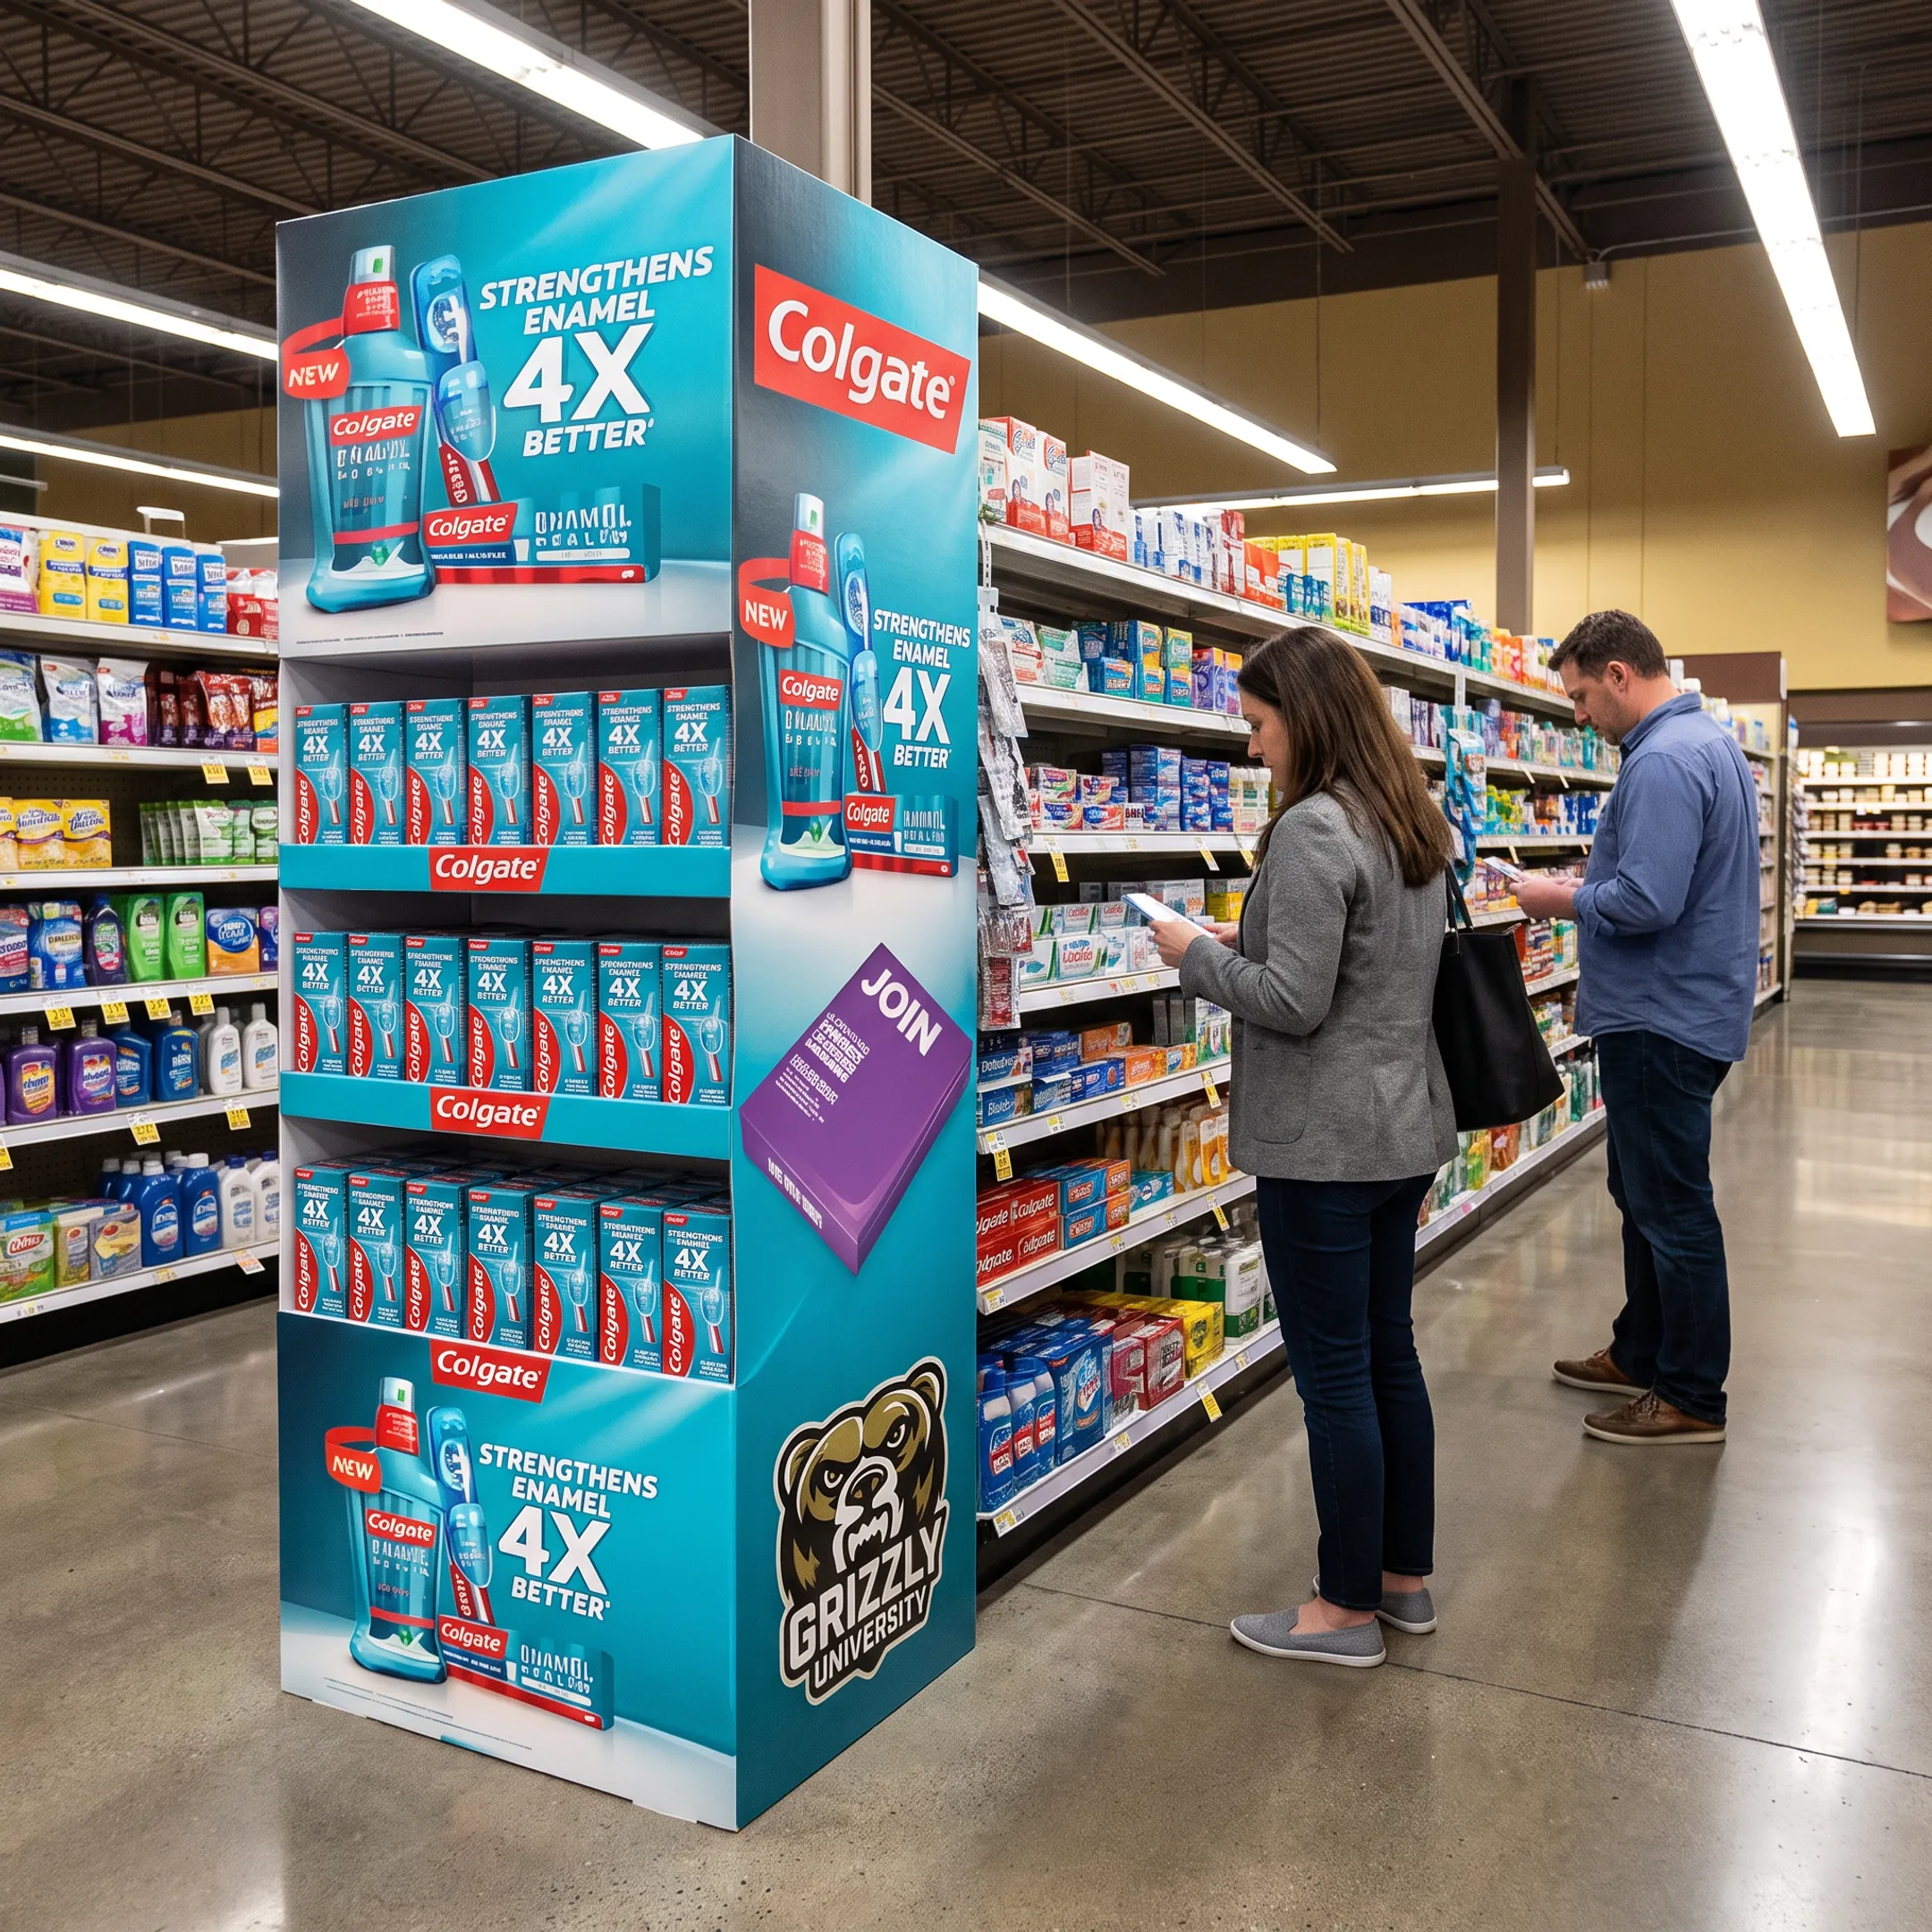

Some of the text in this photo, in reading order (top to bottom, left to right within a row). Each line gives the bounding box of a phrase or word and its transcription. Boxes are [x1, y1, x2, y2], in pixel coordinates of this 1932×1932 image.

[479, 246, 714, 309] STRENGTHENS
[523, 290, 655, 335] ENAMEL
[288, 362, 339, 387] NEW
[504, 323, 654, 423] 4X
[334, 412, 415, 437] Colgate
[428, 514, 508, 539] Colgate
[744, 599, 788, 631] NEW
[873, 608, 971, 648] STRENGTHENS
[893, 642, 951, 670] ENAMEL
[782, 675, 839, 702] Colgate
[884, 666, 952, 744] 4X
[303, 735, 329, 753] 4X
[359, 734, 386, 752] 4X
[415, 733, 444, 750] 4X
[478, 730, 506, 749] 4X
[542, 727, 572, 748] 4X
[608, 724, 640, 744] 4X
[674, 722, 708, 743] 4X
[846, 801, 890, 826] Colgate
[436, 853, 539, 886] Colgate
[302, 962, 328, 981] 4X
[358, 966, 385, 986] 4X
[414, 969, 443, 989] 4X
[478, 972, 507, 993] 4X
[542, 975, 574, 996] 4X
[609, 978, 641, 999] 4X
[674, 979, 708, 1001] 4X
[673, 1000, 708, 1010] BETTER
[861, 969, 943, 1057] JOIN
[436, 1095, 540, 1128] Colgate
[303, 1199, 330, 1220] 4X
[358, 1207, 385, 1228] 4X
[414, 1215, 443, 1236] 4X
[478, 1224, 507, 1246] 4X
[543, 1232, 576, 1255] 4X
[609, 1241, 642, 1264] 4X
[674, 1248, 709, 1272] 4X
[437, 1350, 541, 1390] Colgate
[332, 1455, 374, 1481] NEW
[479, 1443, 658, 1499] STRENGTHENS
[512, 1476, 612, 1519] ENAMEL
[369, 1513, 433, 1541] Colgate
[498, 1504, 612, 1596] 4X
[789, 1517, 943, 1671] GRIZZLY
[441, 1623, 501, 1652] Colgate
[814, 1584, 928, 1689] UNIVERSITY
